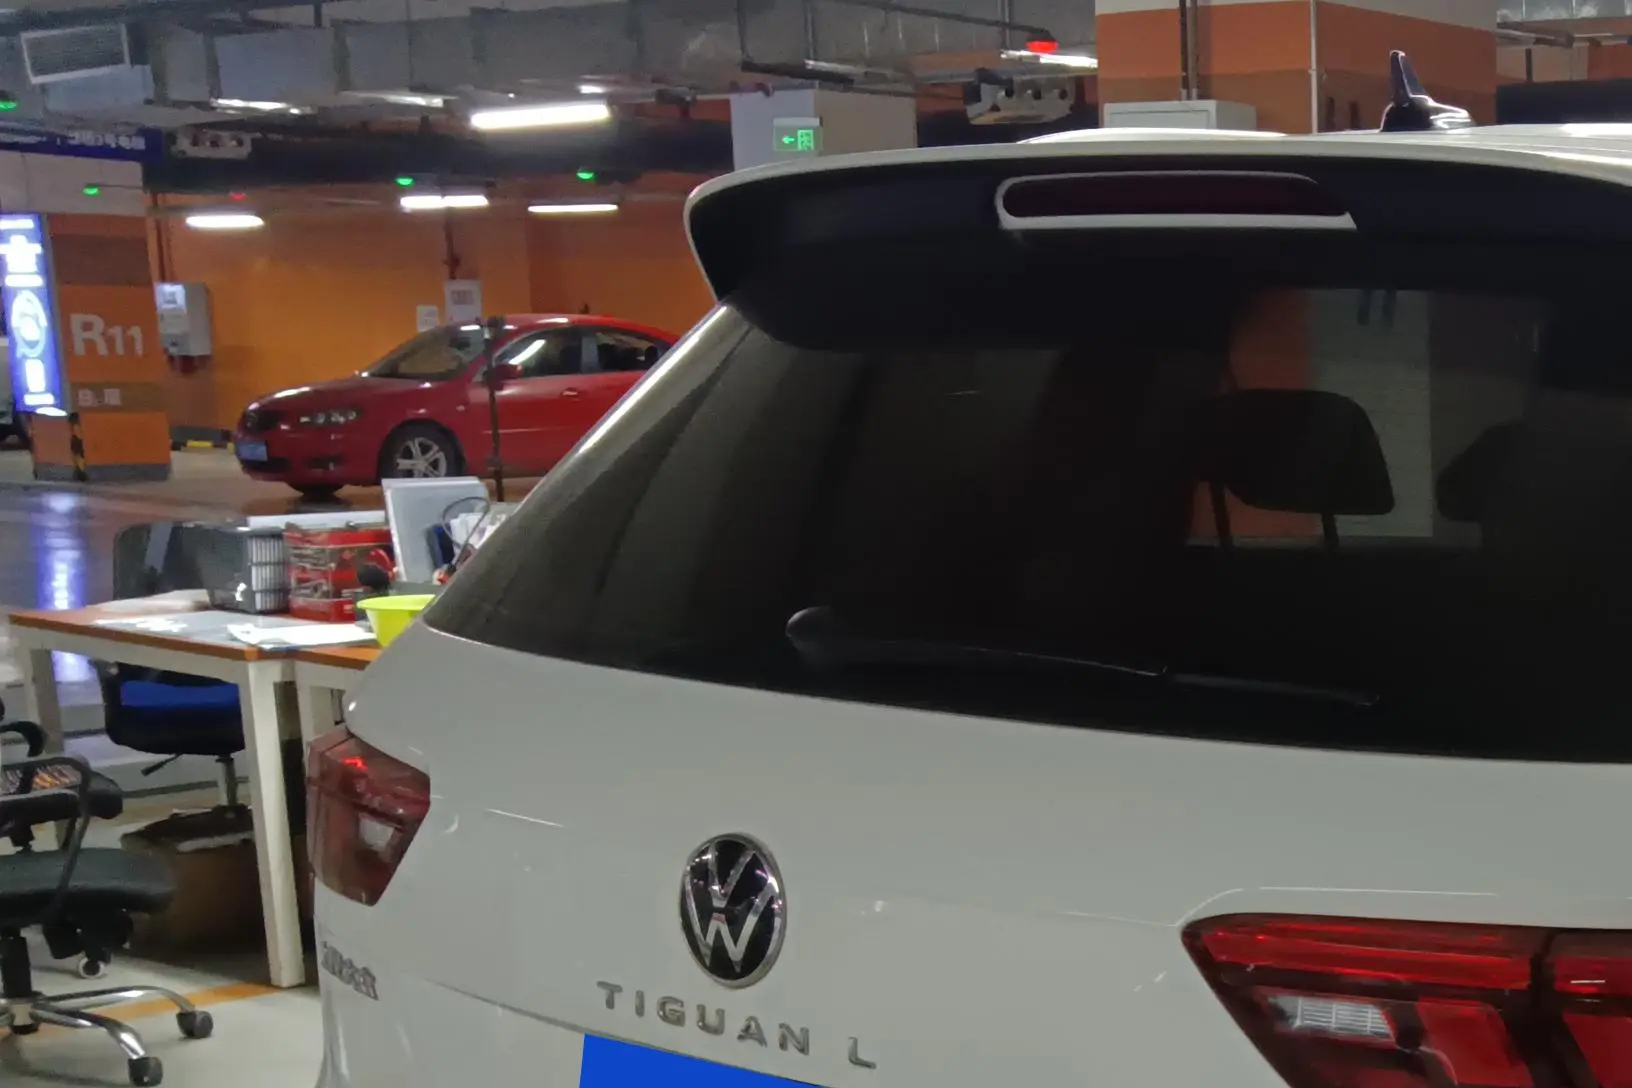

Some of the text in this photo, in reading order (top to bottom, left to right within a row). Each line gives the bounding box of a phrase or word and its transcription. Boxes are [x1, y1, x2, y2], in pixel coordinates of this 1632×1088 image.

[70, 313, 144, 357] R11
[682, 838, 784, 980] VW
[597, 980, 877, 1070] TIGUAN L
